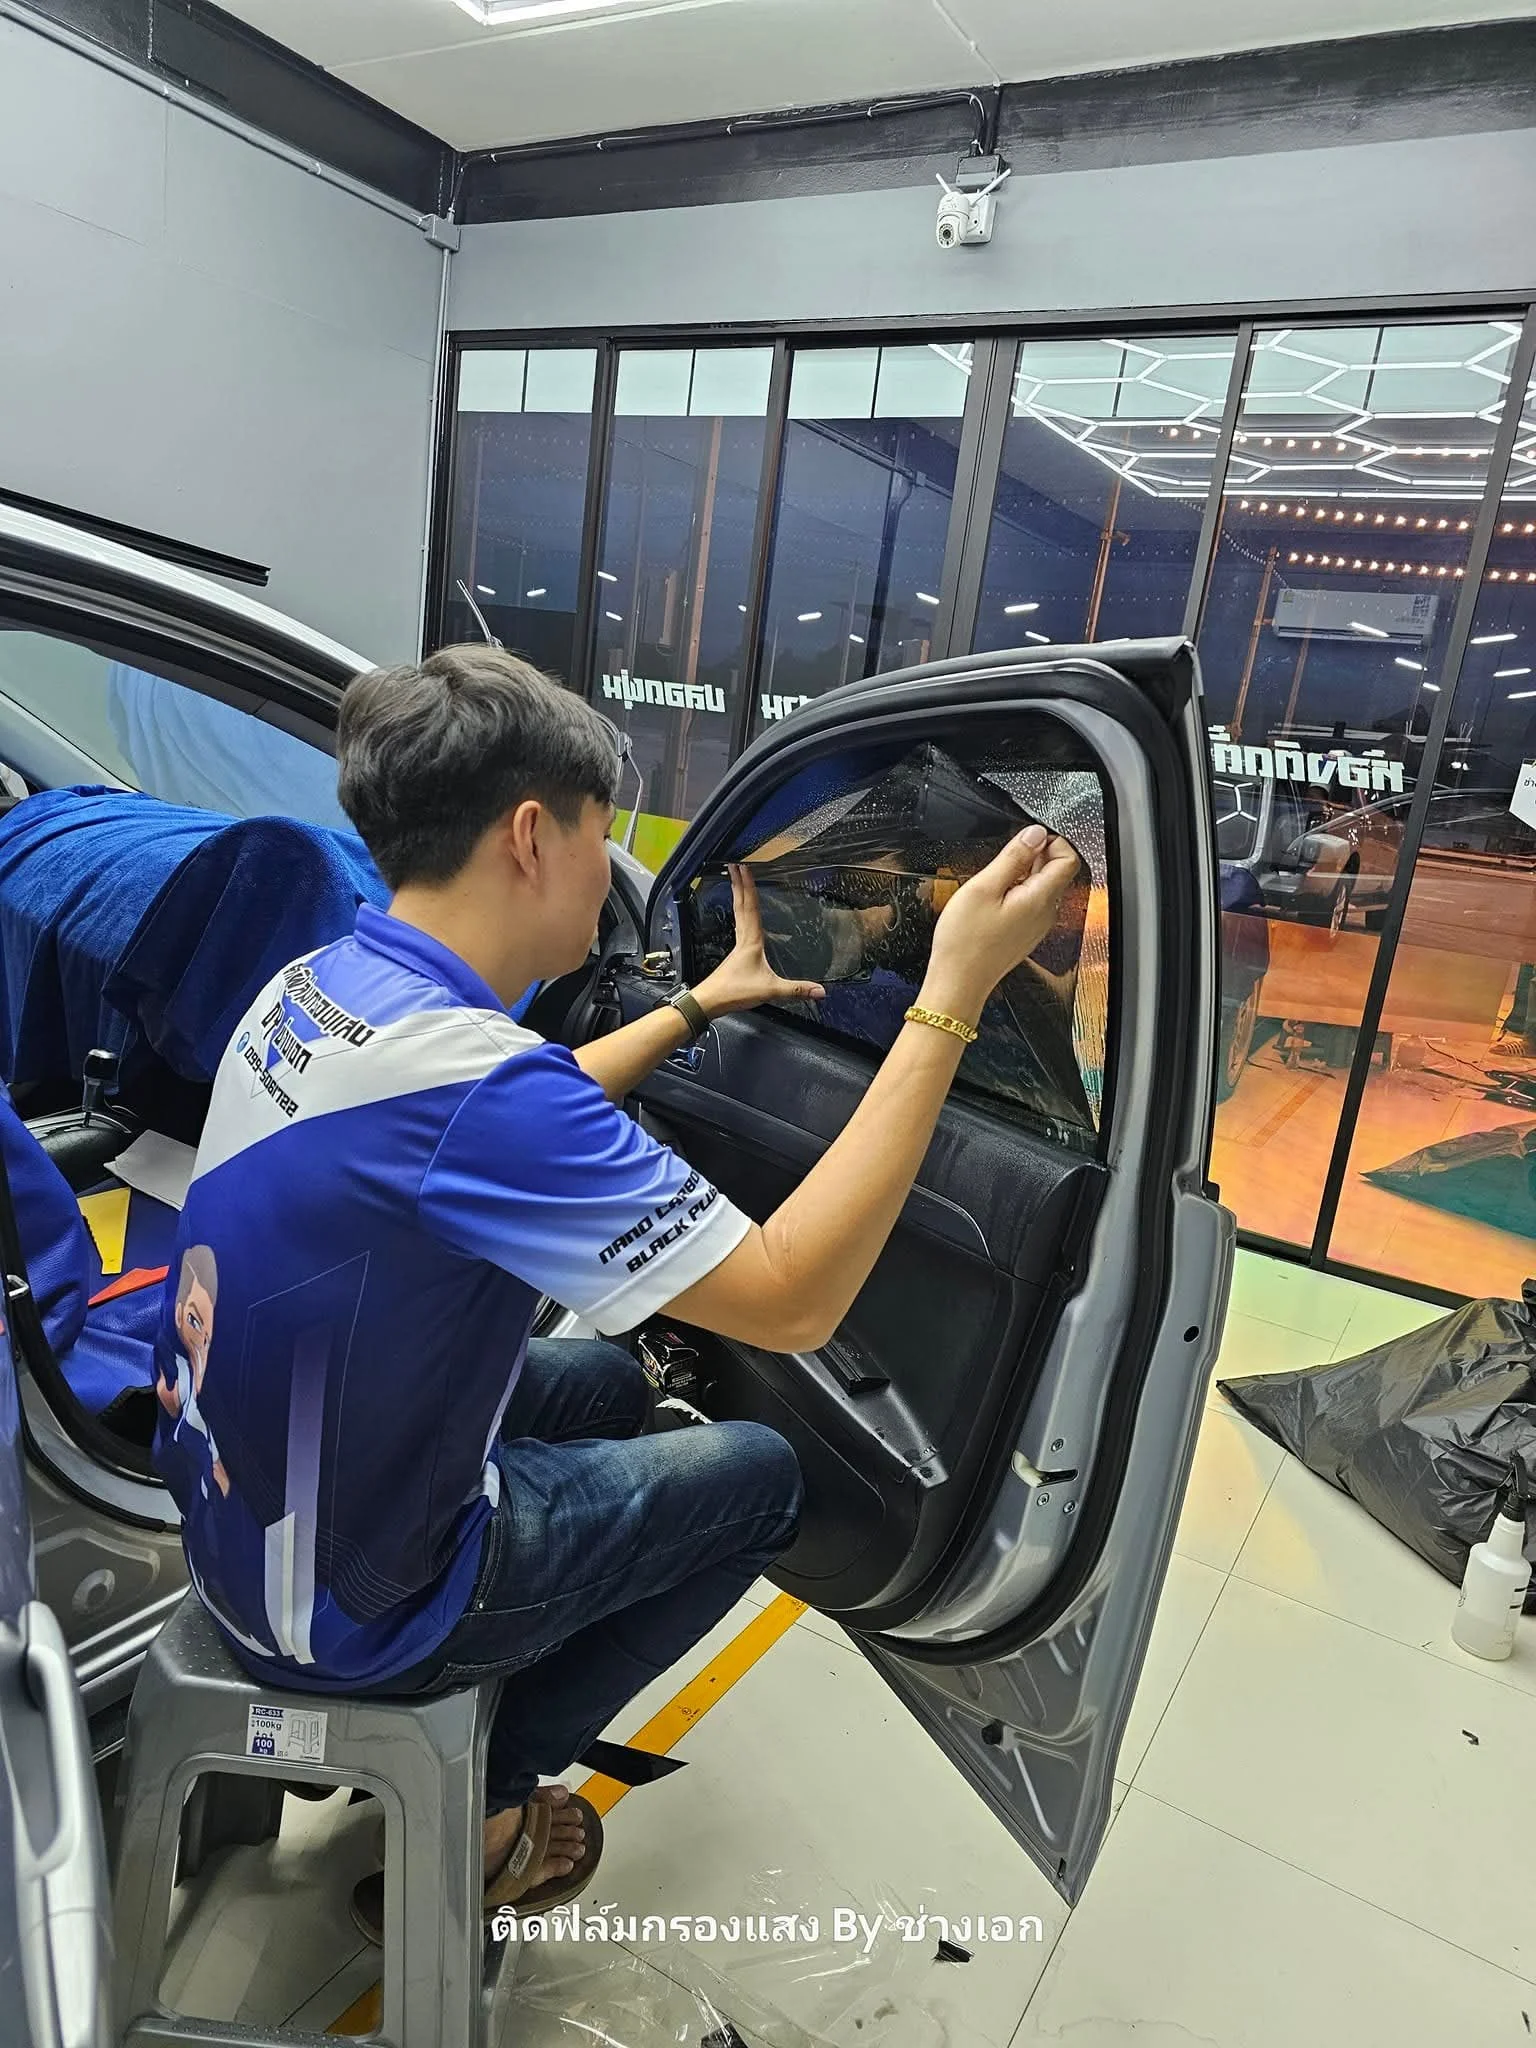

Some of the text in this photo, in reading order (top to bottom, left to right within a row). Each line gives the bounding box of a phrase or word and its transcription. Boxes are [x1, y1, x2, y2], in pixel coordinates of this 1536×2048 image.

[244, 1046, 299, 1118] 099-5061722
[598, 1215, 654, 1265] NANO
[626, 1218, 690, 1273] BLACK
[255, 1739, 273, 1747] 100
